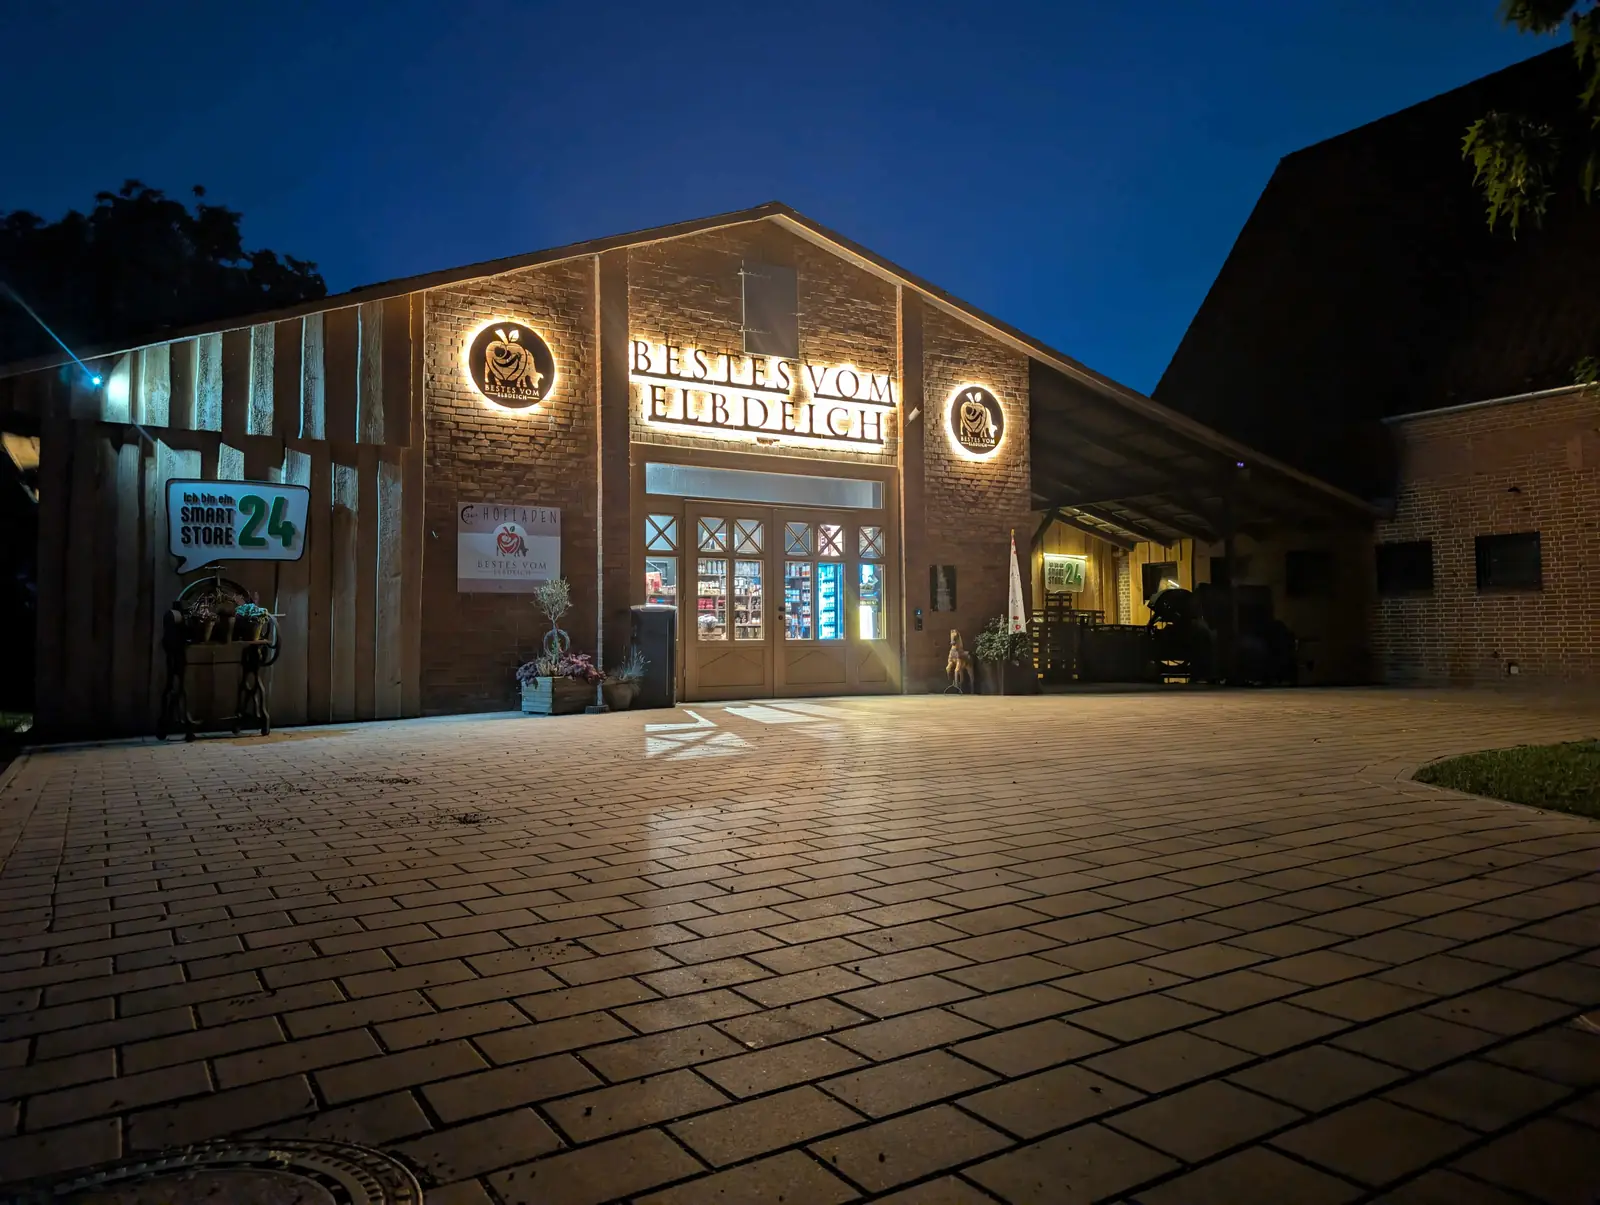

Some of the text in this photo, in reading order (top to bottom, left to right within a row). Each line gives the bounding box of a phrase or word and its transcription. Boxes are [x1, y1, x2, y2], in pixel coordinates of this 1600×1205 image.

[632, 340, 896, 404] BESTES VOM
[485, 384, 540, 397] BESTES VOM
[649, 385, 883, 441] ELBDEICH
[183, 492, 234, 506] Ich bin ein
[181, 506, 235, 525] SMART
[238, 494, 296, 548] 24
[483, 507, 557, 524] HOFLADEN
[181, 526, 234, 546] STORE
[477, 560, 547, 570] BESTES VOM
[1065, 562, 1082, 585] 24
